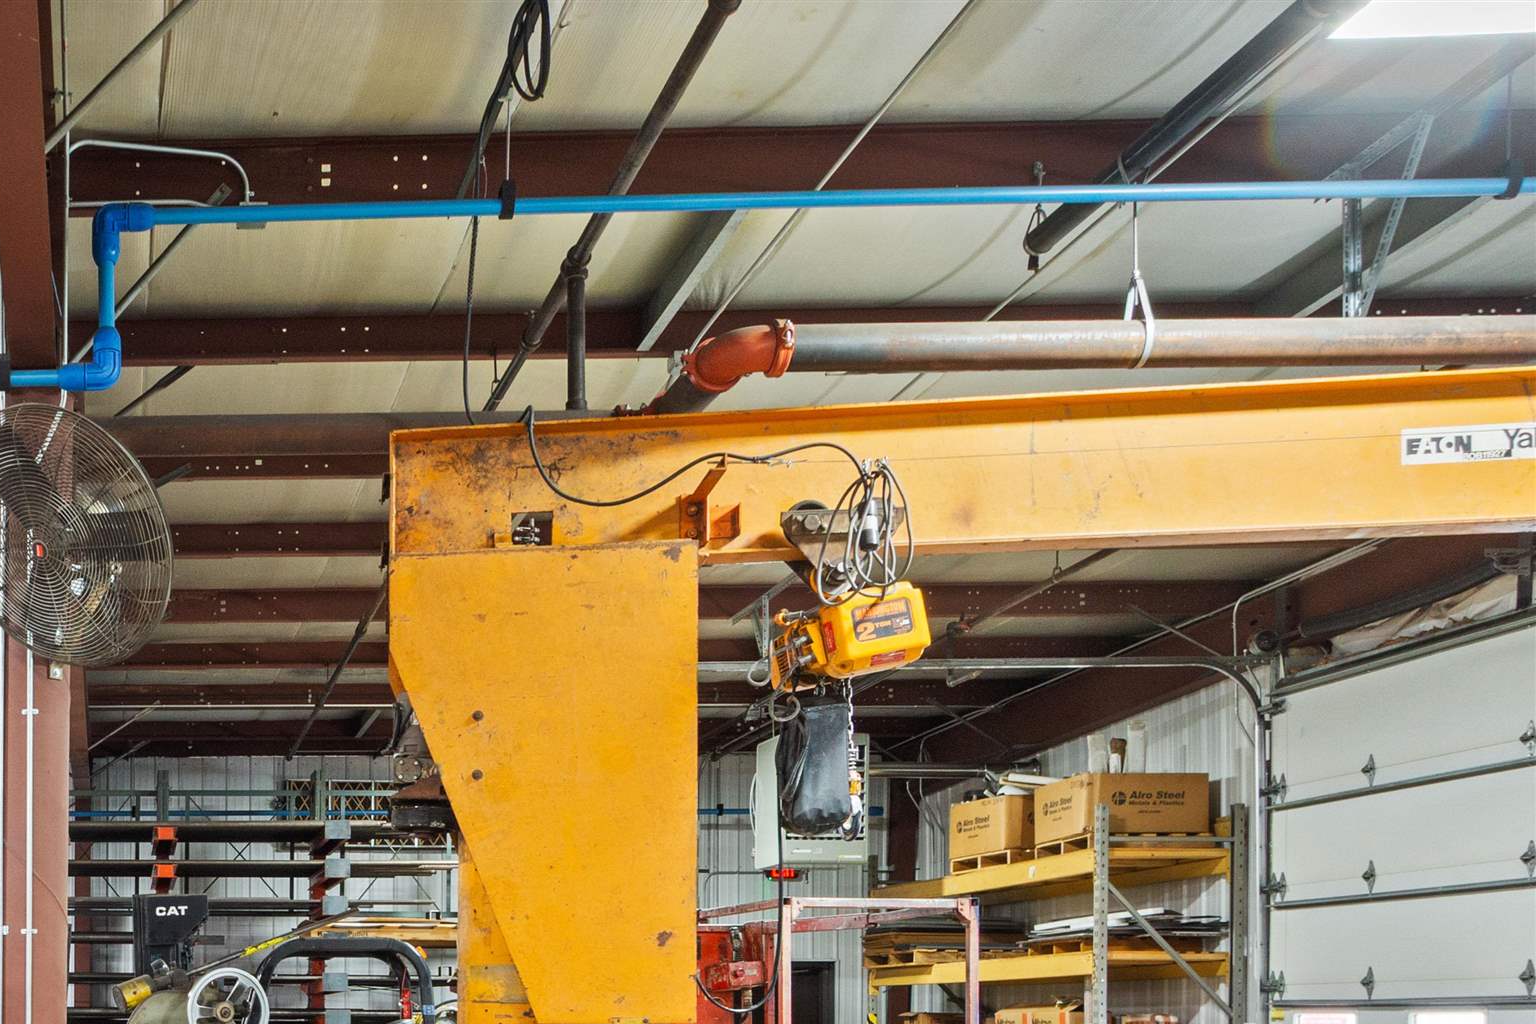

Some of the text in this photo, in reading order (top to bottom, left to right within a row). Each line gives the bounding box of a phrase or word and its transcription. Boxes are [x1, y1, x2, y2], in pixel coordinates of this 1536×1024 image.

[856, 622, 877, 641] 2
[1129, 790, 1185, 800] Alro Steel
[155, 906, 189, 917] CAT
